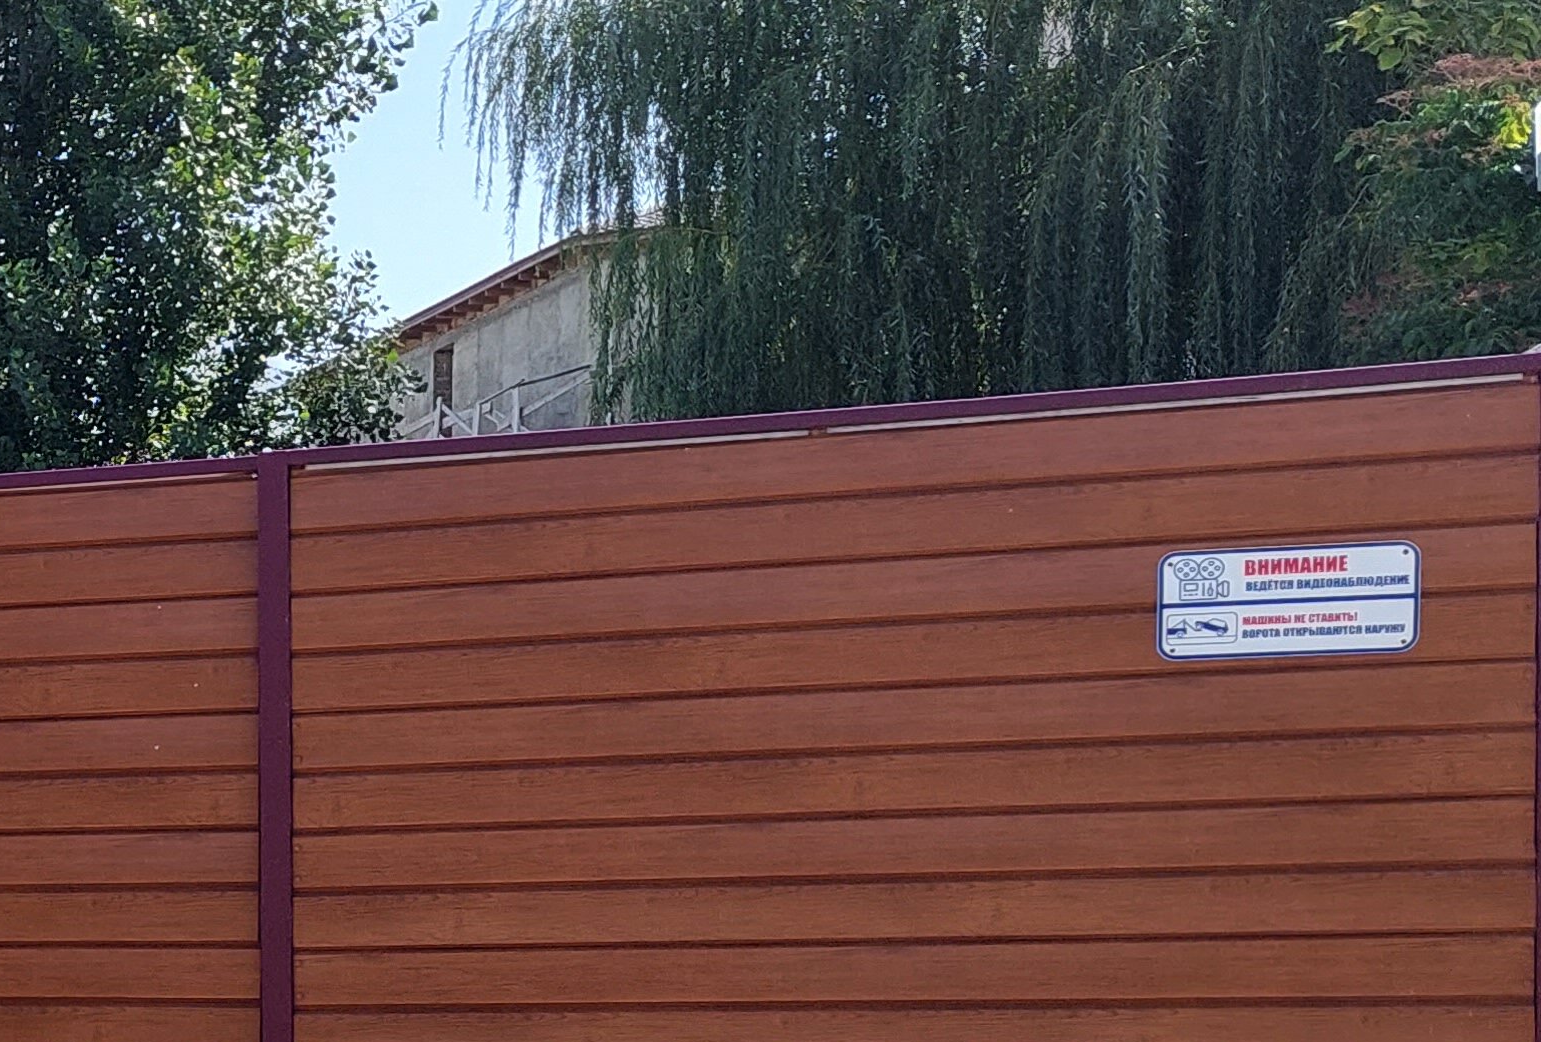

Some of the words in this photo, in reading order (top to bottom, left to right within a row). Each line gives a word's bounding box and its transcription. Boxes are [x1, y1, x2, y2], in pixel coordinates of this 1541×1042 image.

[1244, 555, 1348, 576] ВНИМАНИЕ
[1296, 574, 1410, 590] ВИДЕОНАБЛЮДЕНИЕ
[1242, 614, 1291, 626] МАШИНЫ
[1294, 614, 1306, 624] НЕ
[1308, 611, 1358, 624] СТАВИТЬ!
[1242, 627, 1281, 639] ВОРОТА
[1283, 625, 1363, 638] ОТКРЫВАЮТСЯ
[1364, 623, 1406, 635] НАРУЖУ
